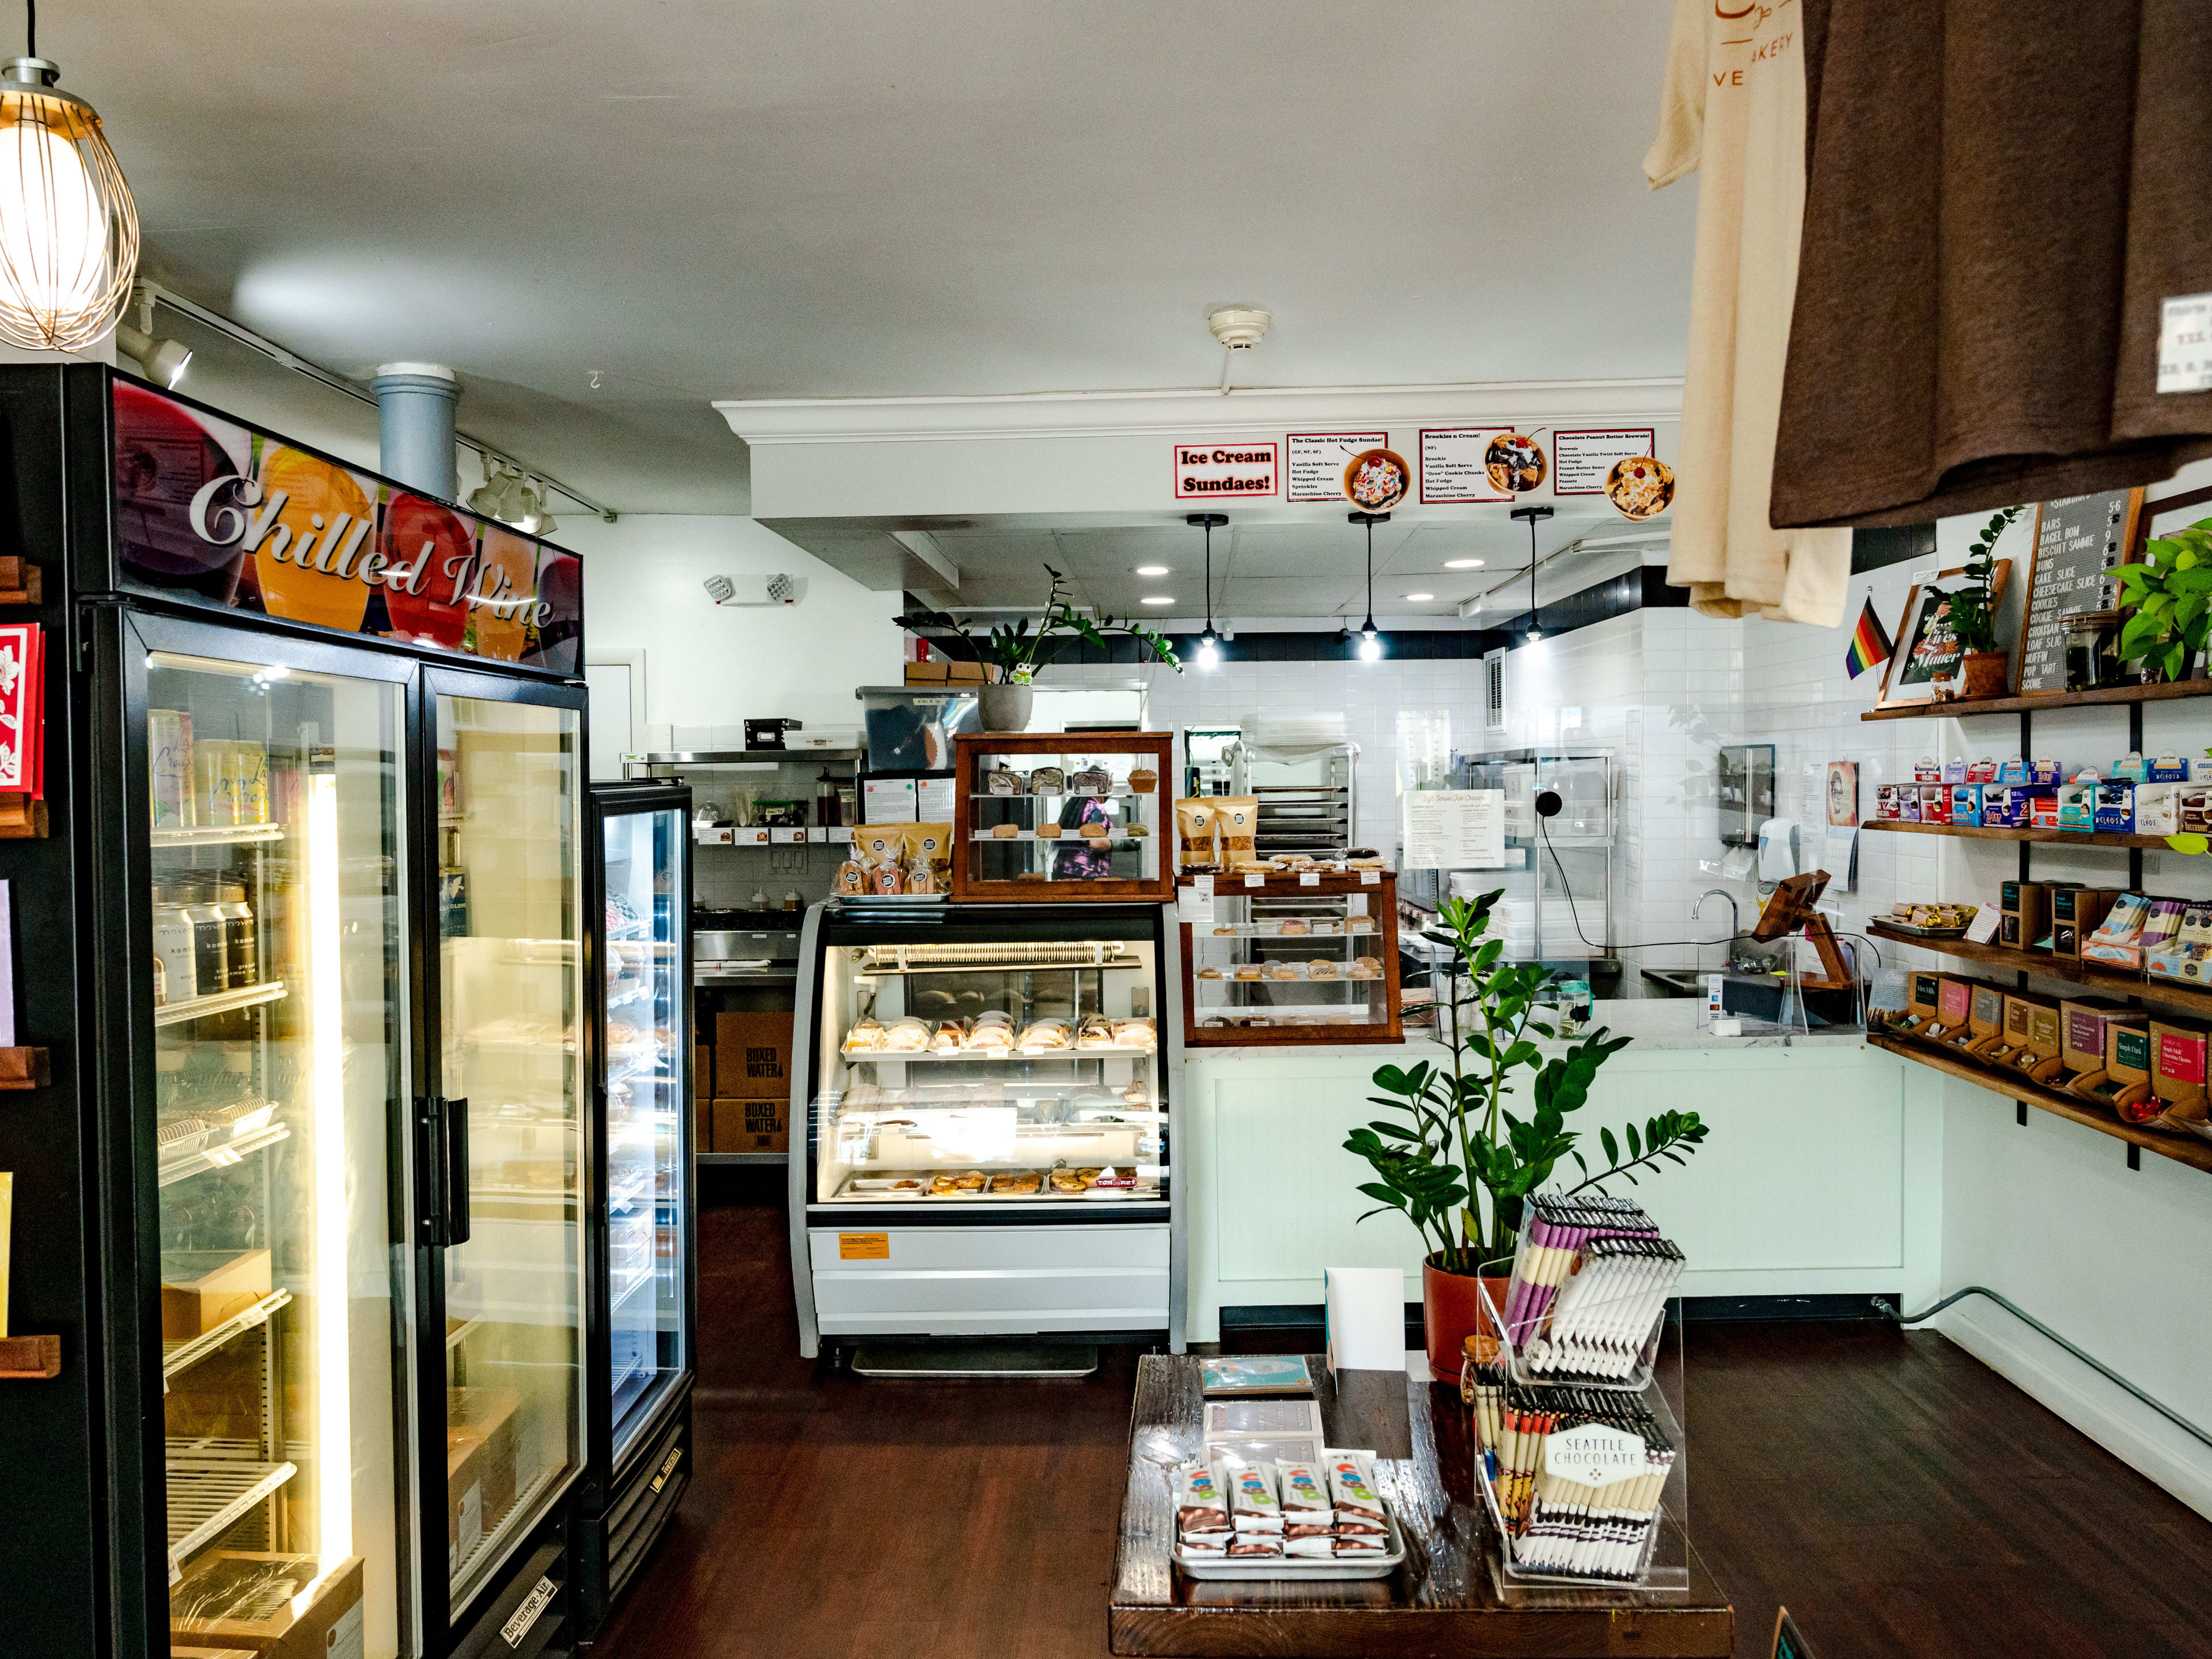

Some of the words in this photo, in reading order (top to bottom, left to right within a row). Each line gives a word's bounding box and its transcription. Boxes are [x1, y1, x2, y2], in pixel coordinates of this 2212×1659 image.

[1181, 451, 1208, 464] Ice
[1212, 450, 1272, 463] Cream
[1183, 476, 1270, 492] Sundaes!
[2041, 518, 2061, 533] BARS
[2038, 542, 2066, 559] BISCUIT
[2068, 535, 2095, 551] SAMMIE
[2105, 530, 2112, 543] 9
[2040, 531, 2062, 546] BAGEL
[188, 475, 435, 596] Chilled
[443, 555, 556, 628] Wine
[2036, 558, 2054, 572] BUNS
[2035, 571, 2052, 585] CAKE
[2057, 566, 2077, 581] SLICE
[2033, 579, 2074, 599] CHEESECAKE
[2077, 575, 2096, 589] SLICE
[2031, 597, 2058, 612] COOKIES
[2030, 610, 2053, 624] COOKIE
[2028, 623, 2060, 639] CROISSAN
[1922, 630, 1959, 650] Lives
[2027, 639, 2044, 651] LOAF
[2046, 635, 2062, 648] SLIC
[2025, 650, 2048, 664] MUFFIN
[2024, 665, 2036, 677] POP
[2041, 662, 2057, 675] TART
[2021, 677, 2043, 691] SCONE
[1435, 794, 1452, 802] Serve
[747, 1047, 777, 1062] BOXED
[2118, 1043, 2131, 1052] Simply
[2131, 1046, 2142, 1055] Dark
[747, 1063, 777, 1078] WATER
[745, 1103, 775, 1118] BOXED
[745, 1118, 777, 1133] WATER
[1566, 1438, 1624, 1451] SEATTLE
[663, 1452, 678, 1474] FREEZER
[1555, 1452, 1637, 1466] CHOCOLATE
